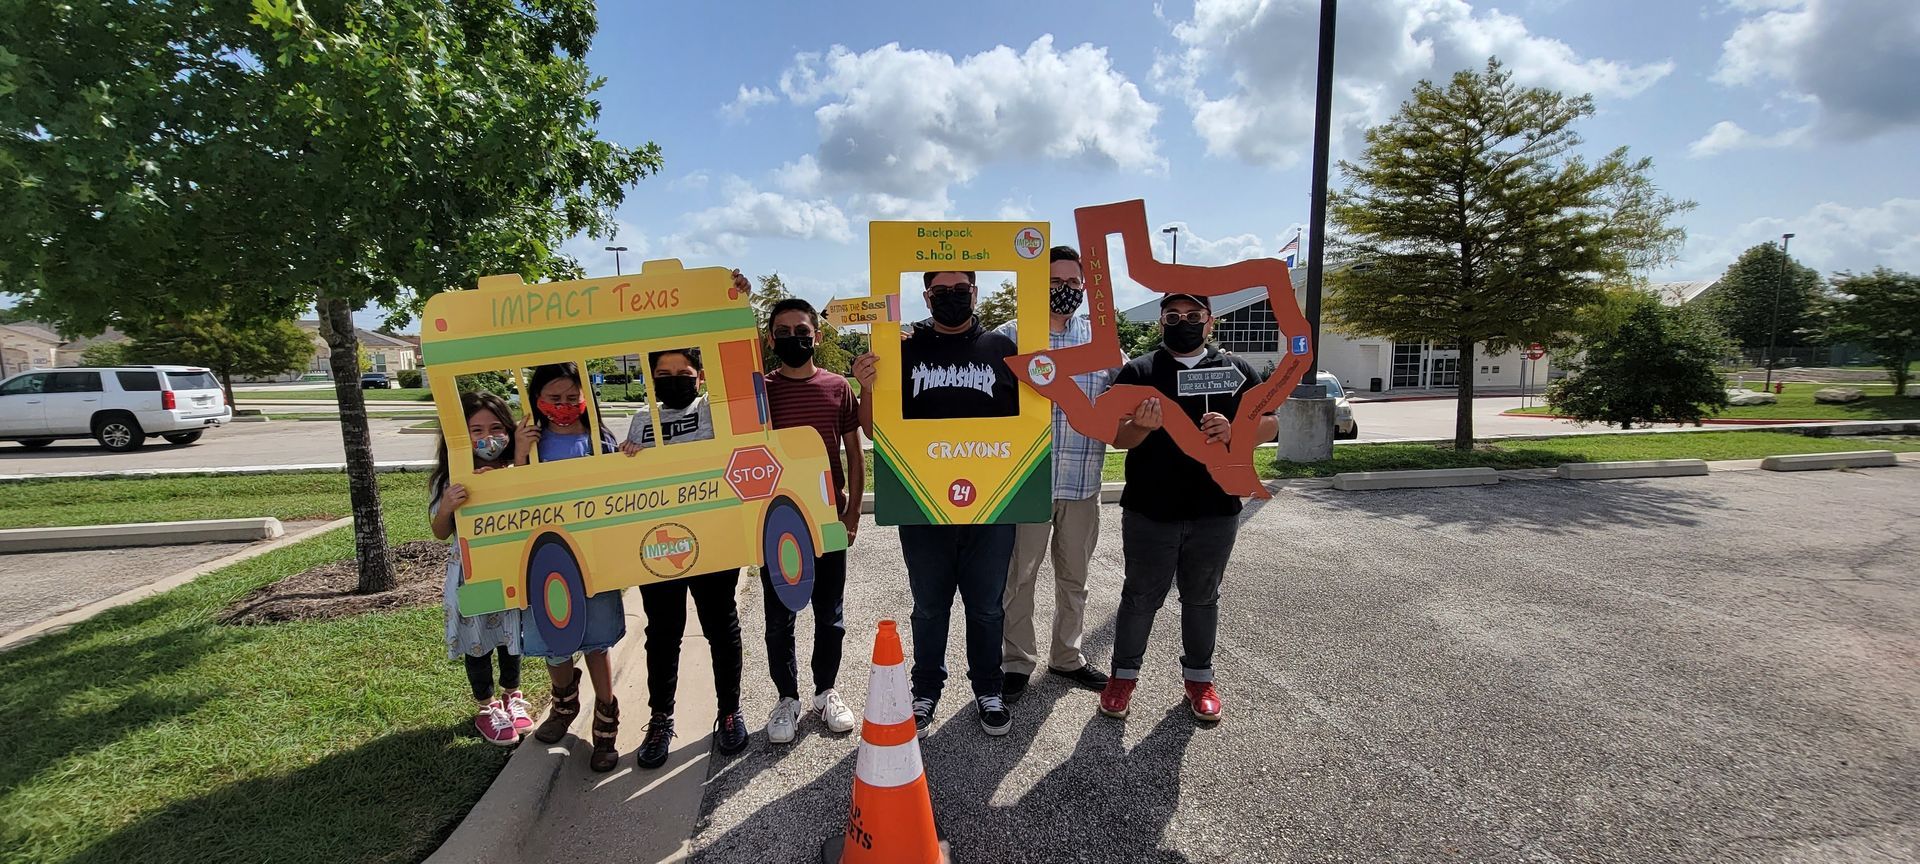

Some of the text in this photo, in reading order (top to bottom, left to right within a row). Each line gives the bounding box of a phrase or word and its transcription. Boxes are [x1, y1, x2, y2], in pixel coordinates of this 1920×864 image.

[917, 227, 972, 239] Backpack
[939, 241, 952, 251] To
[1090, 246, 1107, 326] IMPACT
[492, 283, 680, 327] IMPACT Texas
[861, 300, 886, 310] Sass
[849, 313, 877, 322] Class
[911, 362, 996, 398] THRASHER
[1223, 380, 1238, 388] Not
[927, 441, 1011, 458] CRAYONS
[733, 465, 775, 483] STOP
[952, 484, 971, 501] 24
[473, 481, 719, 535] BACKPACK TO SCHOOL BASH
[643, 537, 694, 559] IMPACT
